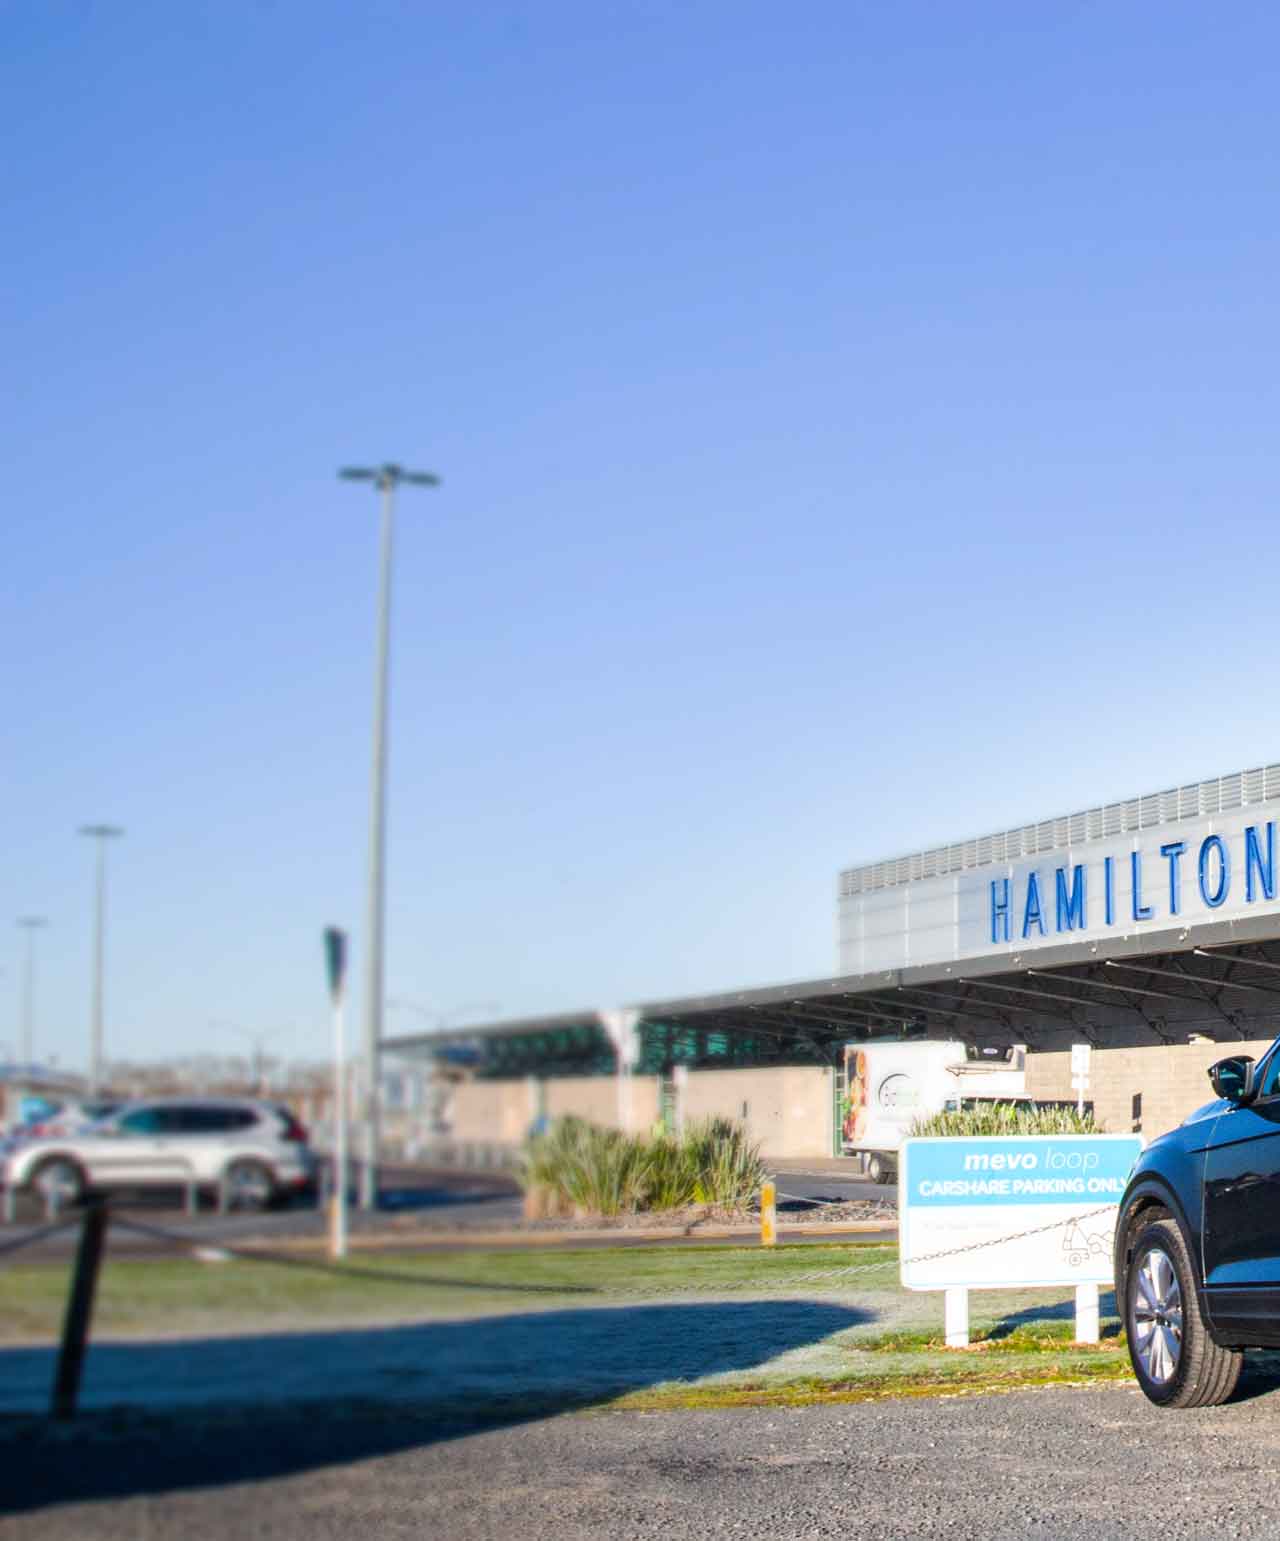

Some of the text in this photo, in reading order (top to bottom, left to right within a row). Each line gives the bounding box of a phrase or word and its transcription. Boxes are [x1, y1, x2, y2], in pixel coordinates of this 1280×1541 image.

[989, 820, 1279, 945] HAMILTON
[964, 1146, 1098, 1177] mevo loop
[918, 1178, 1011, 1197] CARSHARE
[1012, 1177, 1086, 1195] PARKING
